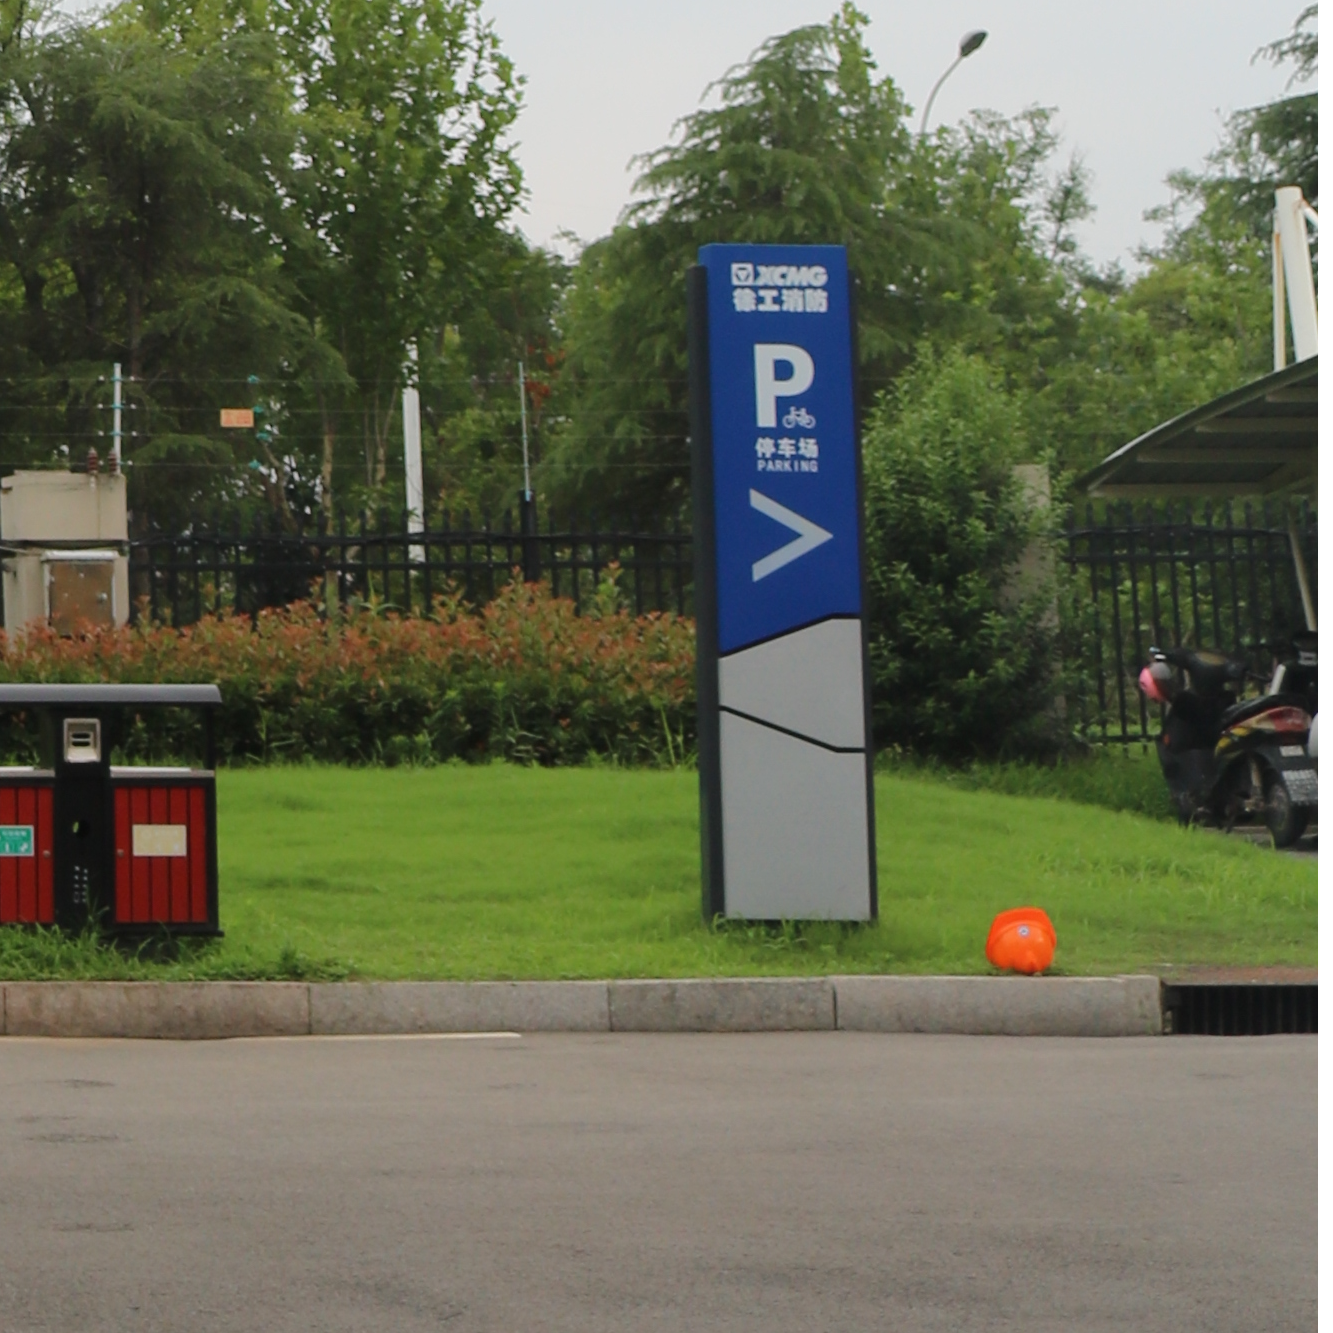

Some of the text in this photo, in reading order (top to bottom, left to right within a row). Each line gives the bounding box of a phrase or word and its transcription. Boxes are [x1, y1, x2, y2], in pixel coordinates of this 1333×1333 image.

[754, 265, 829, 287] XCMG
[754, 343, 815, 428] P
[755, 436, 820, 459] 停车场
[756, 459, 819, 472] PARKING
